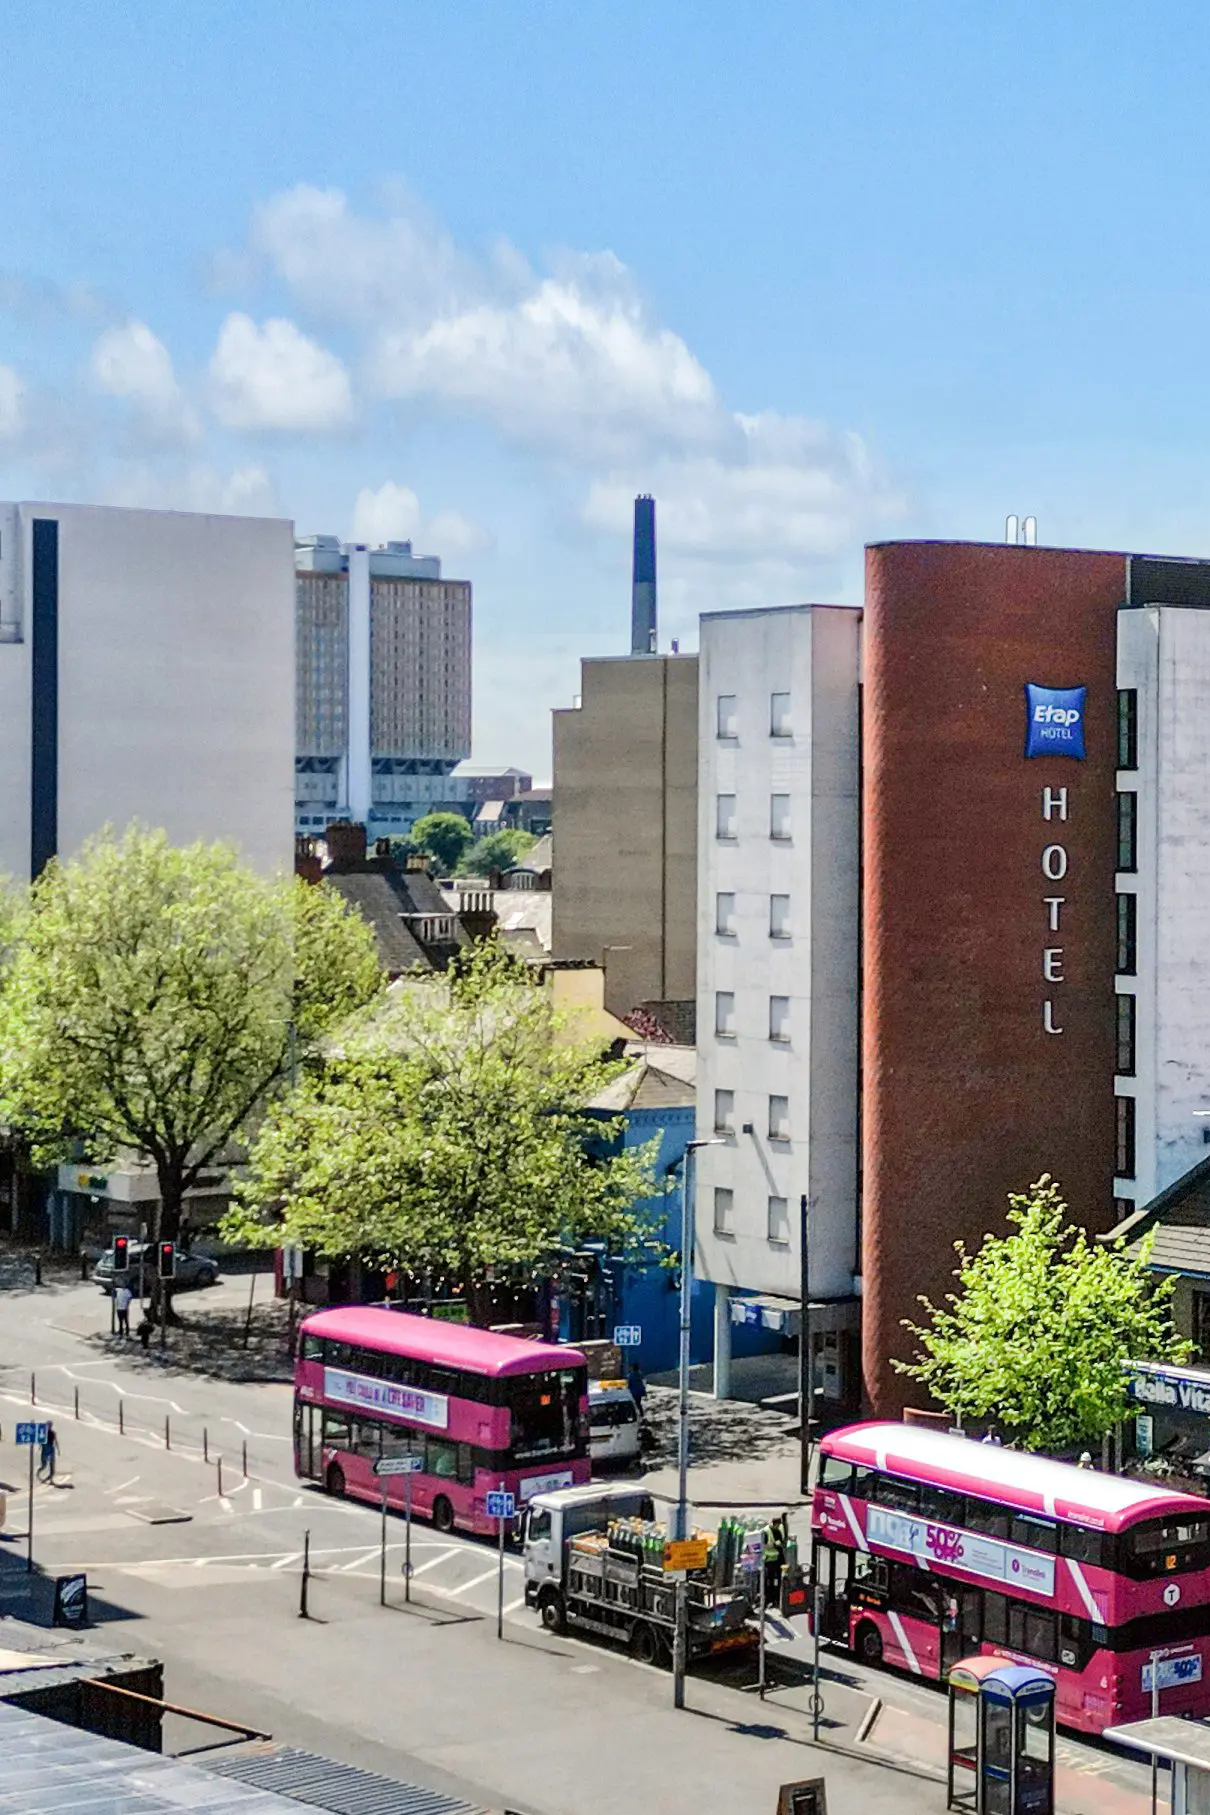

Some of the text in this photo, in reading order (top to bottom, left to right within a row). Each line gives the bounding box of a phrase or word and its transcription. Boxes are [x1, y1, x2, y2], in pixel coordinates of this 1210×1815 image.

[1034, 704, 1080, 727] Etap
[1041, 728, 1073, 740] HOTEL
[1042, 786, 1068, 1034] HOTEL
